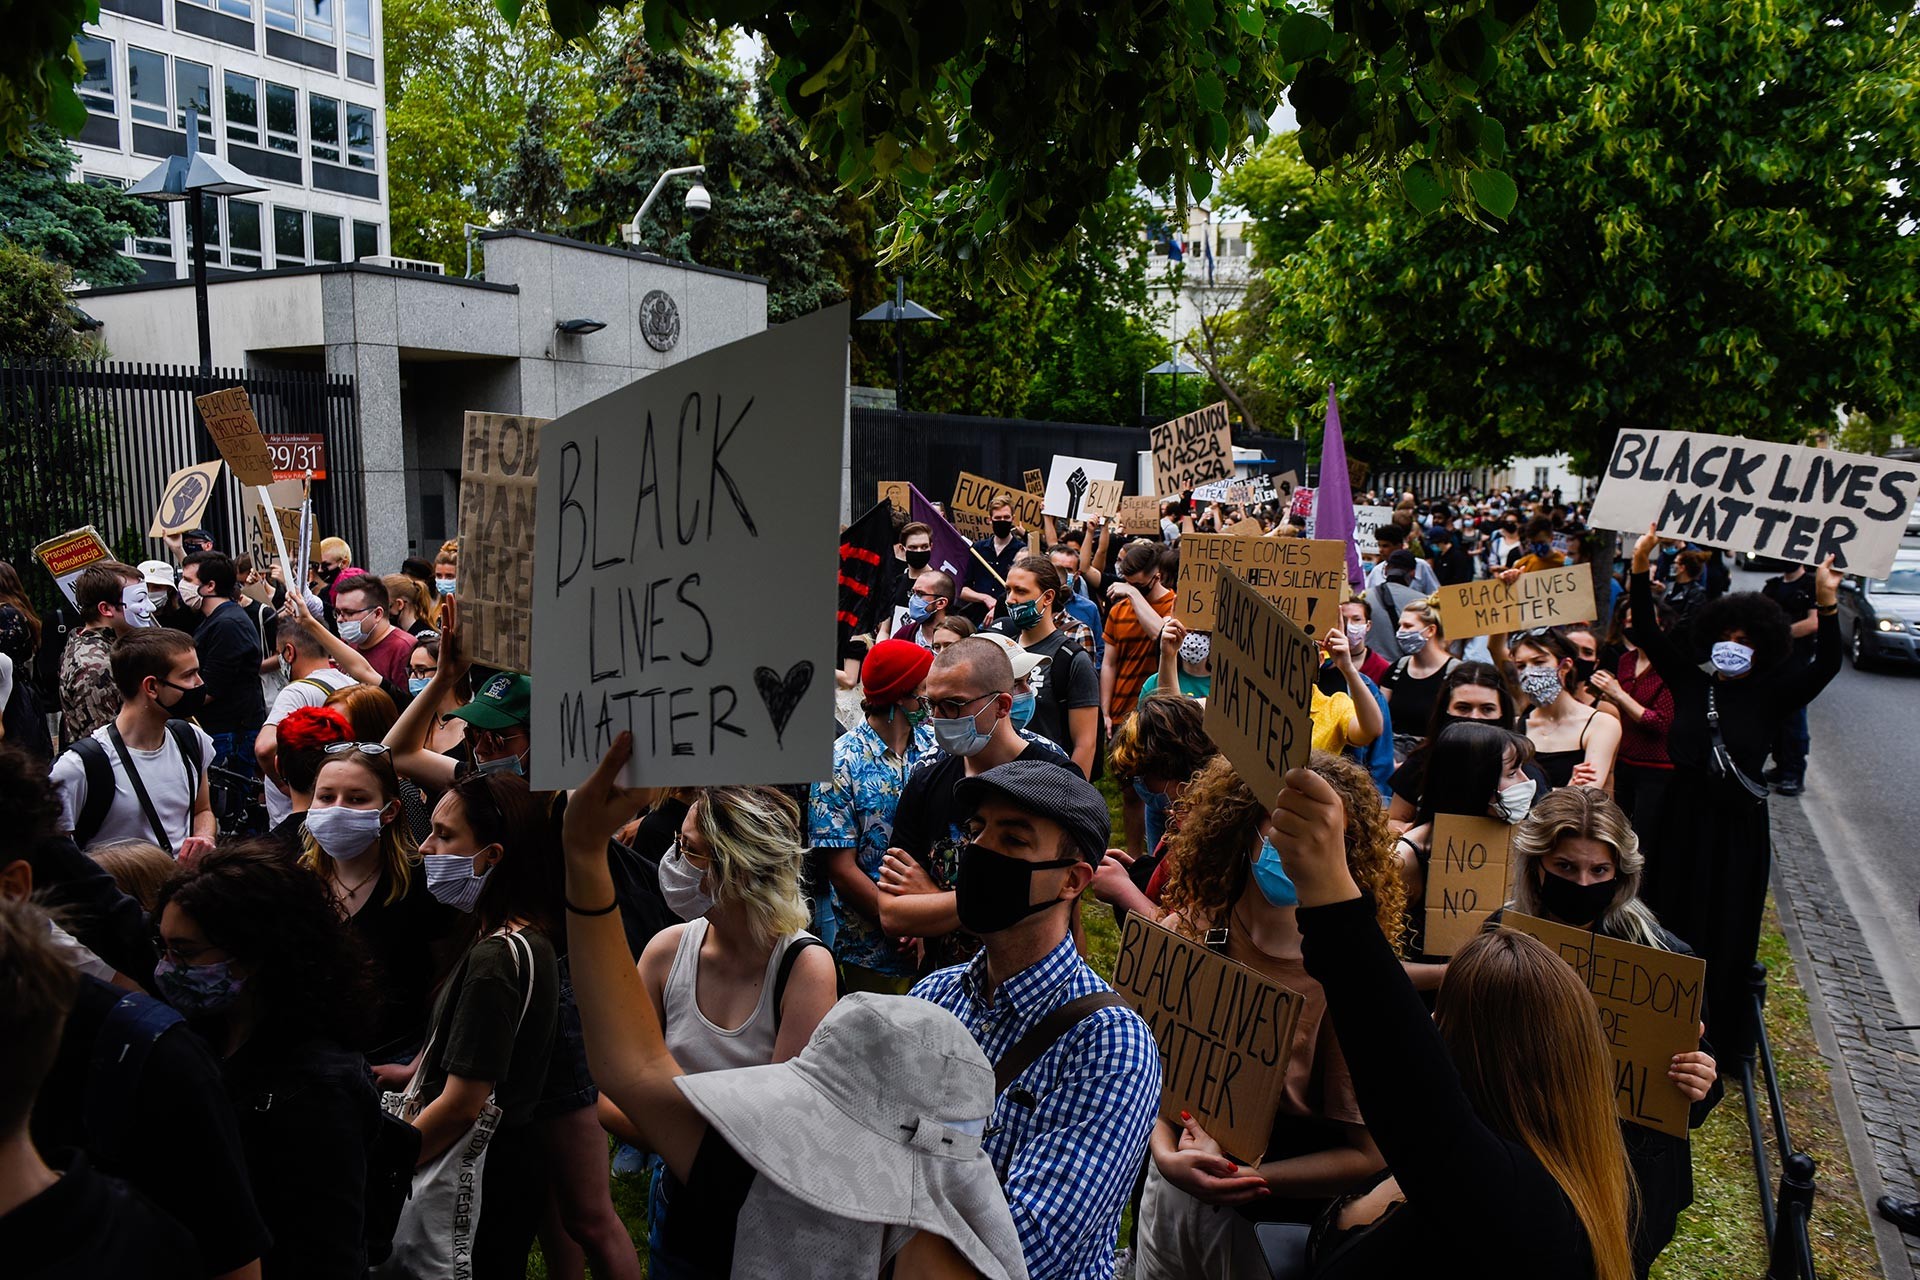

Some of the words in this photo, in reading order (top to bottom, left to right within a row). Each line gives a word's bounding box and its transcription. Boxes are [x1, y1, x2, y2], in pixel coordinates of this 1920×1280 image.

[197, 394, 231, 418] BLACK
[209, 414, 253, 440] MATTERS
[1152, 424, 1173, 454] ZA
[266, 443, 317, 471] 29/31
[1609, 433, 1767, 495] BLACK
[1768, 454, 1918, 521] LIVES
[557, 392, 759, 597] BLACK
[956, 478, 999, 511] FUCK
[1087, 482, 1119, 516] BLM
[956, 512, 991, 526] SILENC
[1656, 489, 1859, 569] MATTER
[43, 537, 93, 562] Pracownicza
[52, 548, 99, 571] Demokracja
[1183, 538, 1245, 562] THERE
[1253, 541, 1311, 566] COMES
[1179, 563, 1190, 581] A
[1280, 569, 1340, 590] SILENCE
[1458, 583, 1515, 607] BLACK
[1524, 572, 1577, 600] LIVES
[1186, 590, 1204, 614] IS
[1474, 597, 1560, 628] MATTER
[590, 572, 713, 685] LIVES
[1217, 576, 1259, 661] BLACK
[1263, 615, 1310, 710] LIVES
[560, 684, 748, 767] MATTER
[1213, 652, 1294, 778] MATTER
[1445, 835, 1487, 874] NO
[1443, 887, 1477, 919] NO
[1115, 918, 1206, 1023] BLACK
[1207, 963, 1290, 1068] LIVES
[1559, 942, 1699, 1025] FREEDOM
[455, 1171, 473, 1258] STEDELIJK
